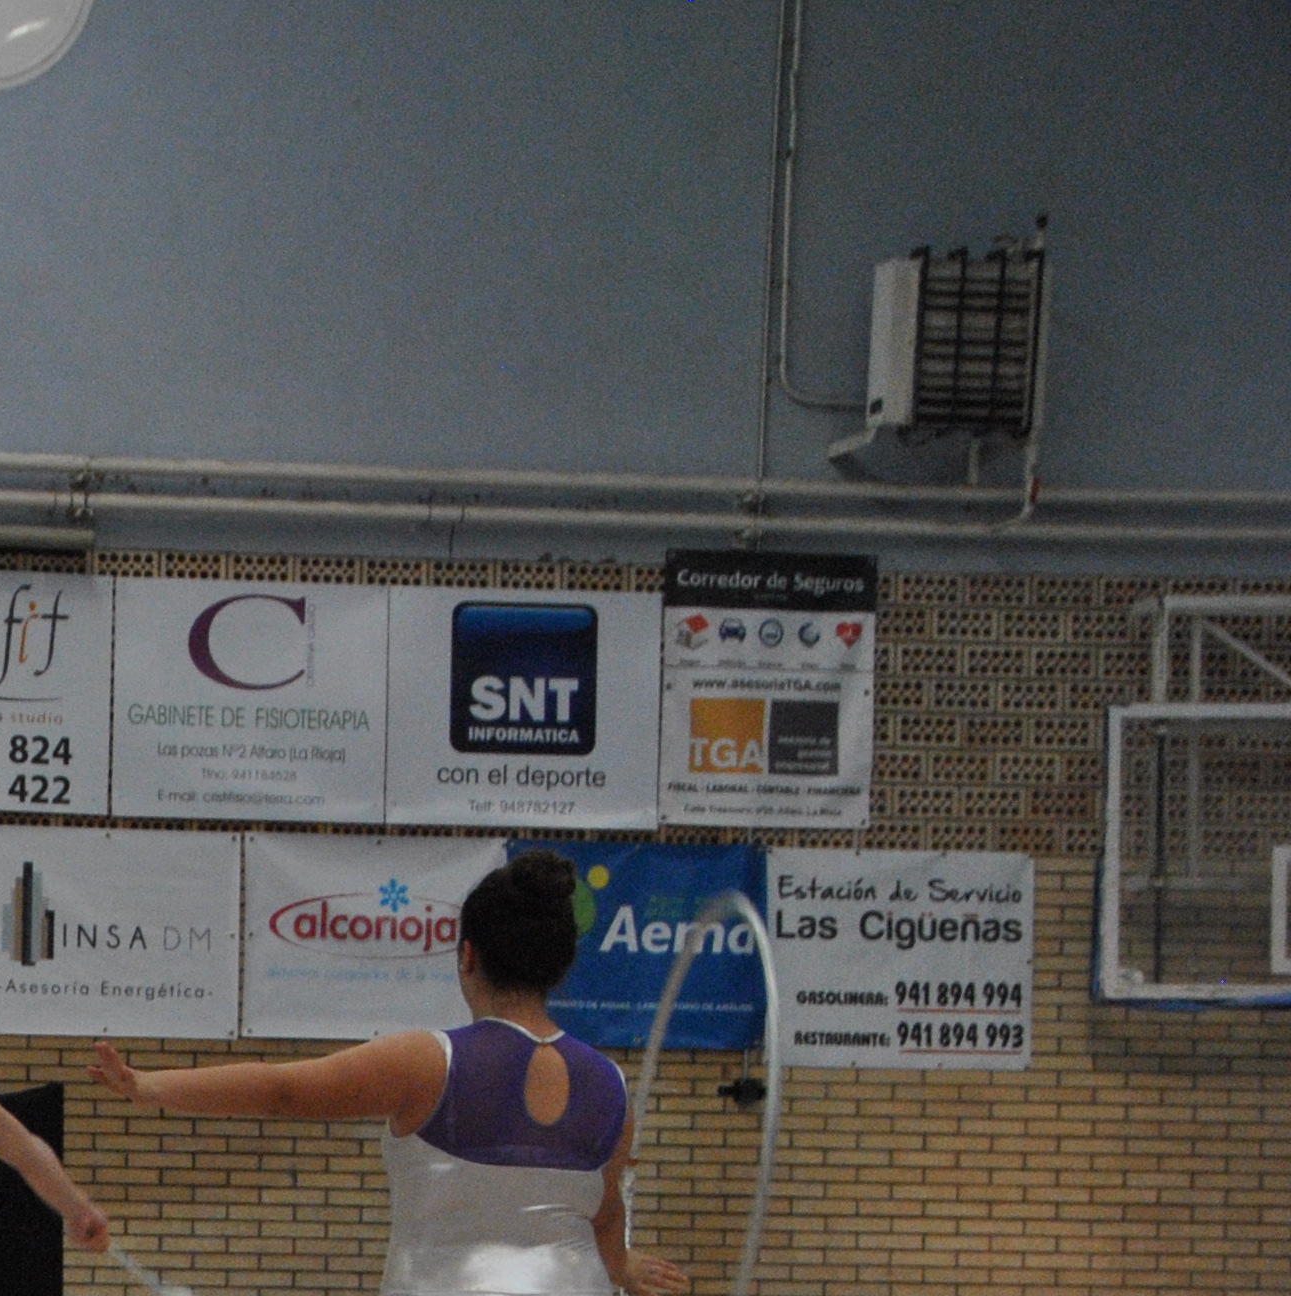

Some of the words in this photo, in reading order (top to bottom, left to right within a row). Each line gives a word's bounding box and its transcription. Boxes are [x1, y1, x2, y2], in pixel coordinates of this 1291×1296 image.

[677, 569, 760, 590] Corredor
[766, 571, 788, 590] de
[793, 572, 865, 595] Seguros
[470, 675, 579, 723] SNT
[10, 711, 64, 726] studio
[128, 703, 215, 727] GABINETE
[221, 706, 246, 727] DE
[255, 707, 370, 731] FISIOTERAPIA
[468, 726, 580, 744] INFORMATICA
[8, 734, 72, 766] 824
[690, 738, 765, 769] TGA
[8, 774, 71, 804] 422
[437, 766, 480, 784] con
[487, 764, 508, 785] el
[516, 765, 607, 791] deporte
[777, 874, 876, 901] Estación
[888, 879, 918, 902] de
[928, 877, 1023, 903] Servicio
[162, 927, 213, 952] DM
[293, 898, 457, 953] alcorioja
[775, 910, 838, 940] Las
[859, 910, 1023, 950] Cigüeñas
[796, 990, 889, 1006] GASOLINERA:
[895, 980, 931, 1007] 941
[938, 981, 976, 1008] 894
[983, 982, 1023, 1008] 994
[793, 1030, 891, 1047] RESTAURANTE:
[897, 1021, 933, 1047] 941
[939, 1022, 978, 1048] 894
[985, 1023, 1025, 1049] 993
